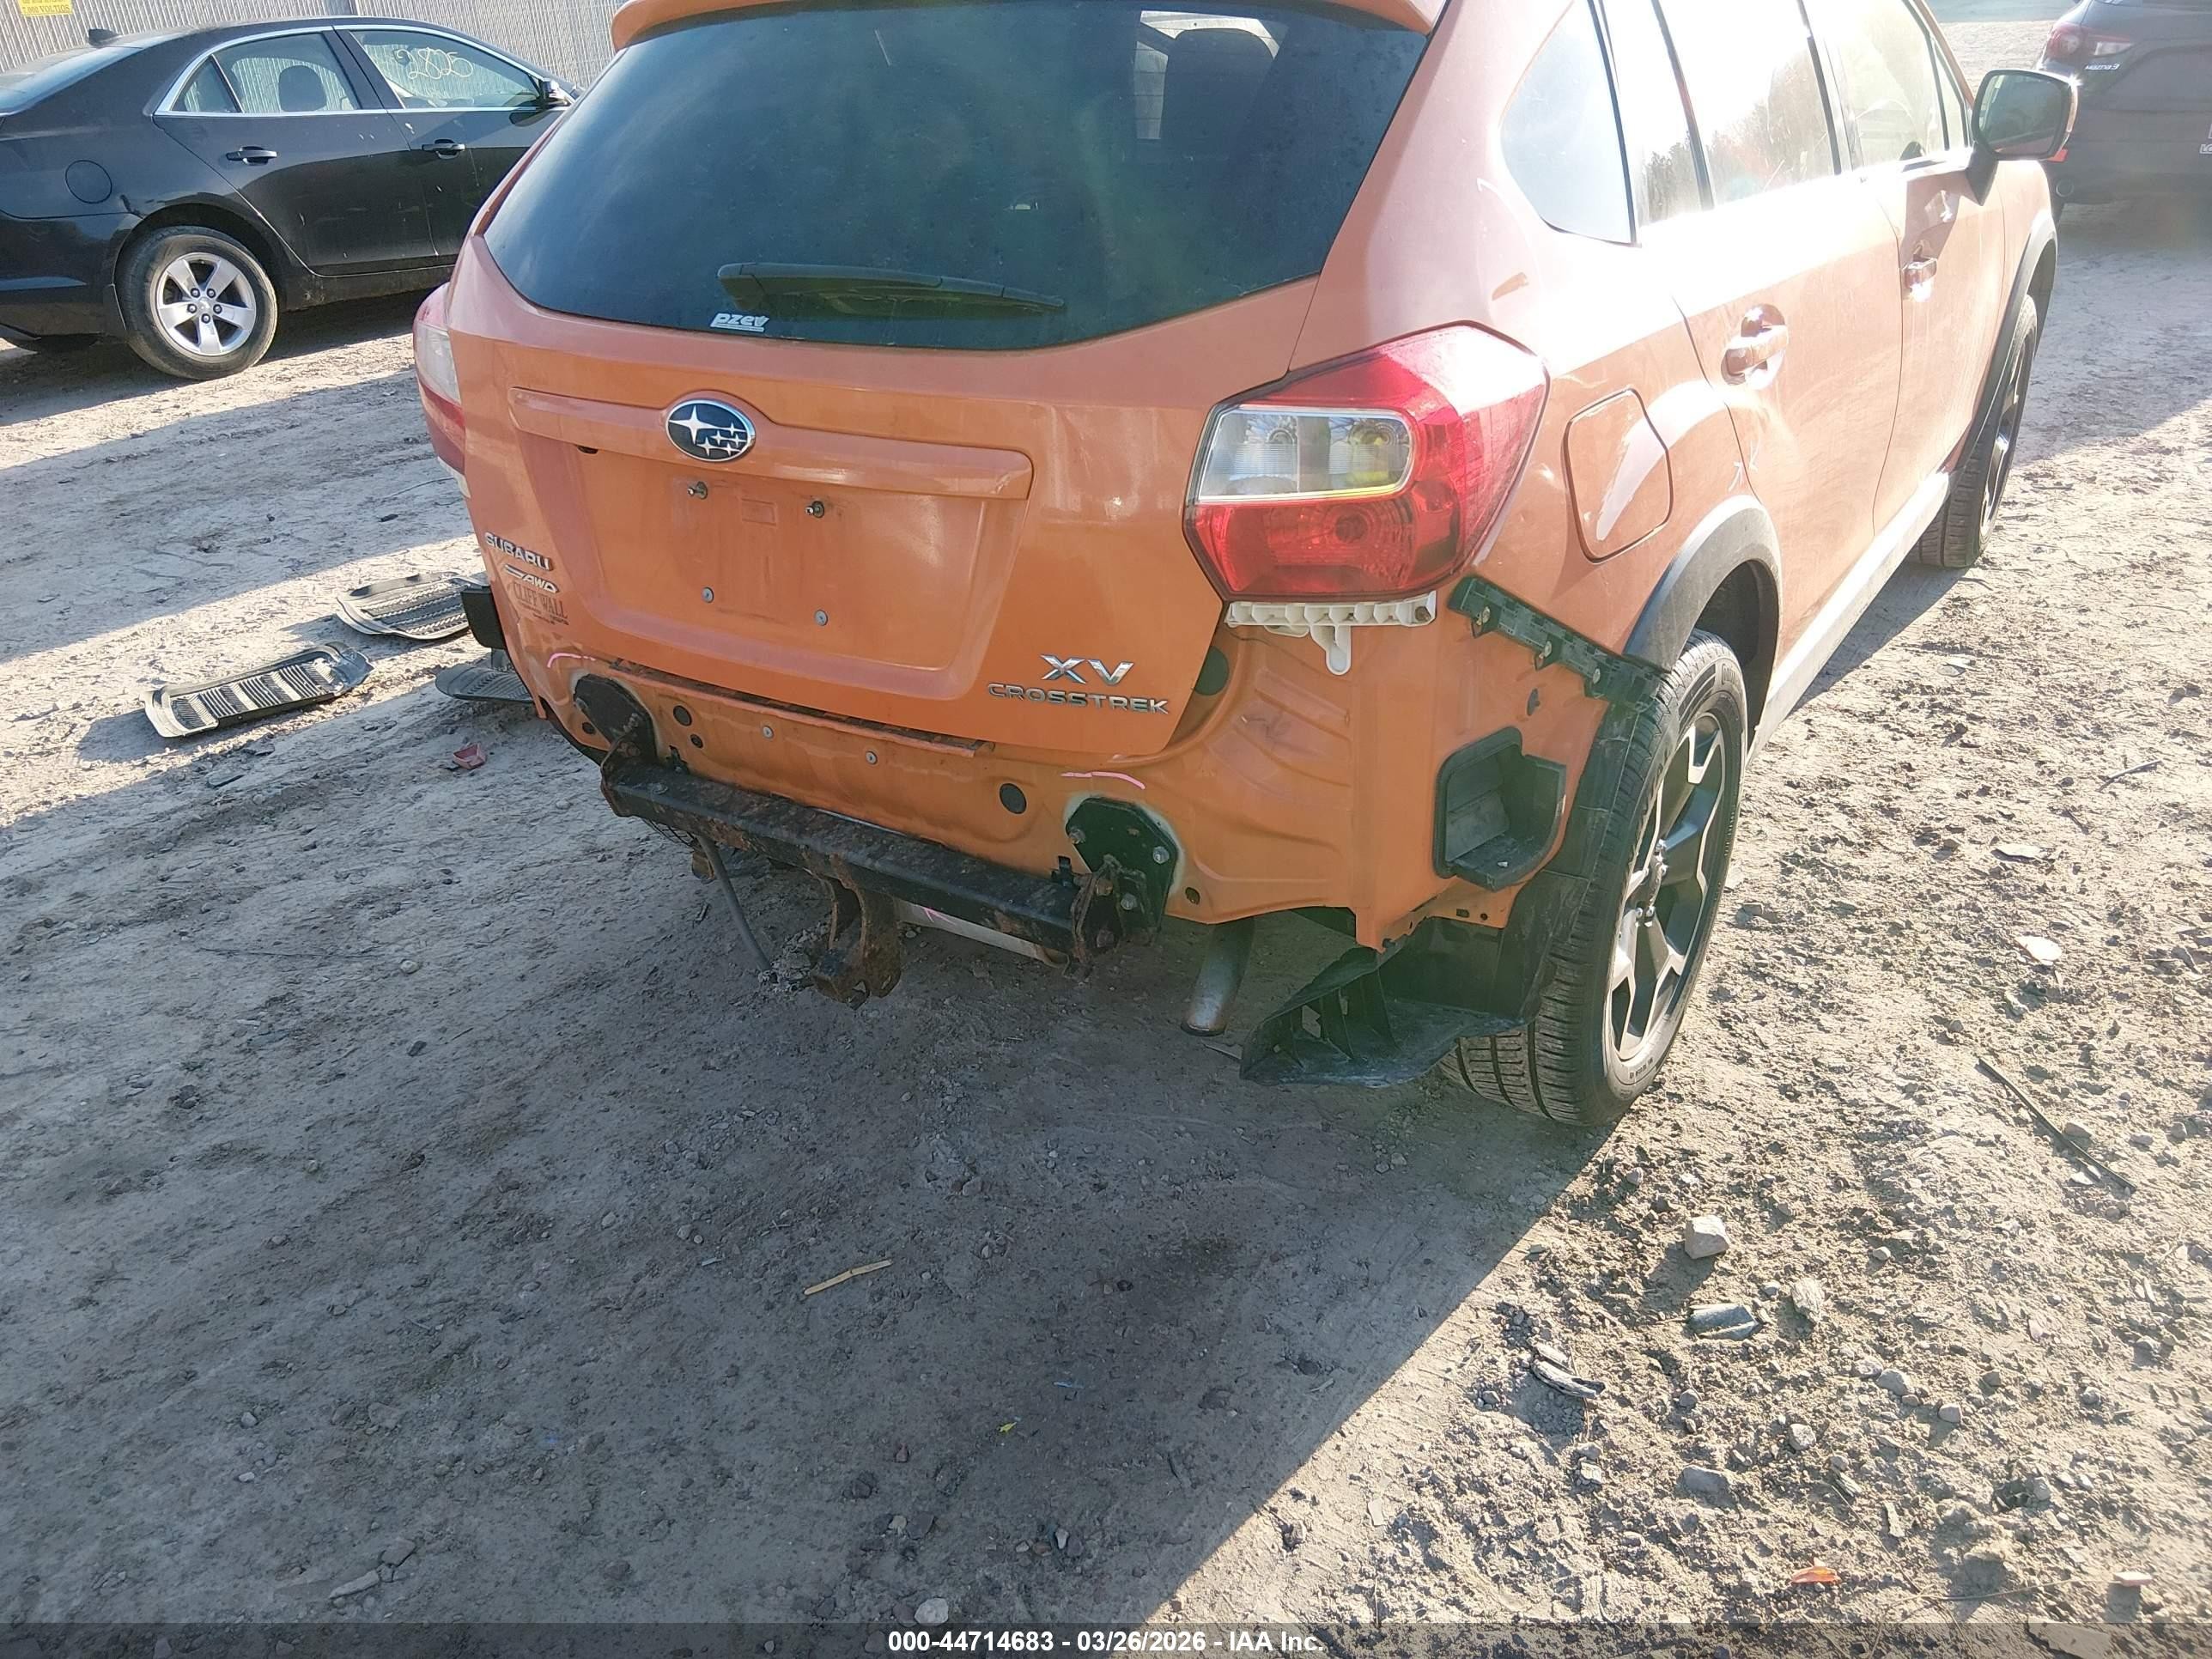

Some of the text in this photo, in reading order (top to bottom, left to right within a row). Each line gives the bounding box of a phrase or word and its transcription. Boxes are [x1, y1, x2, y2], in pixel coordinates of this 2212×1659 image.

[484, 532, 552, 571] SUBARU
[522, 574, 559, 593] AWD
[1040, 653, 1134, 686] XV
[988, 684, 1169, 714] CROSSTREK
